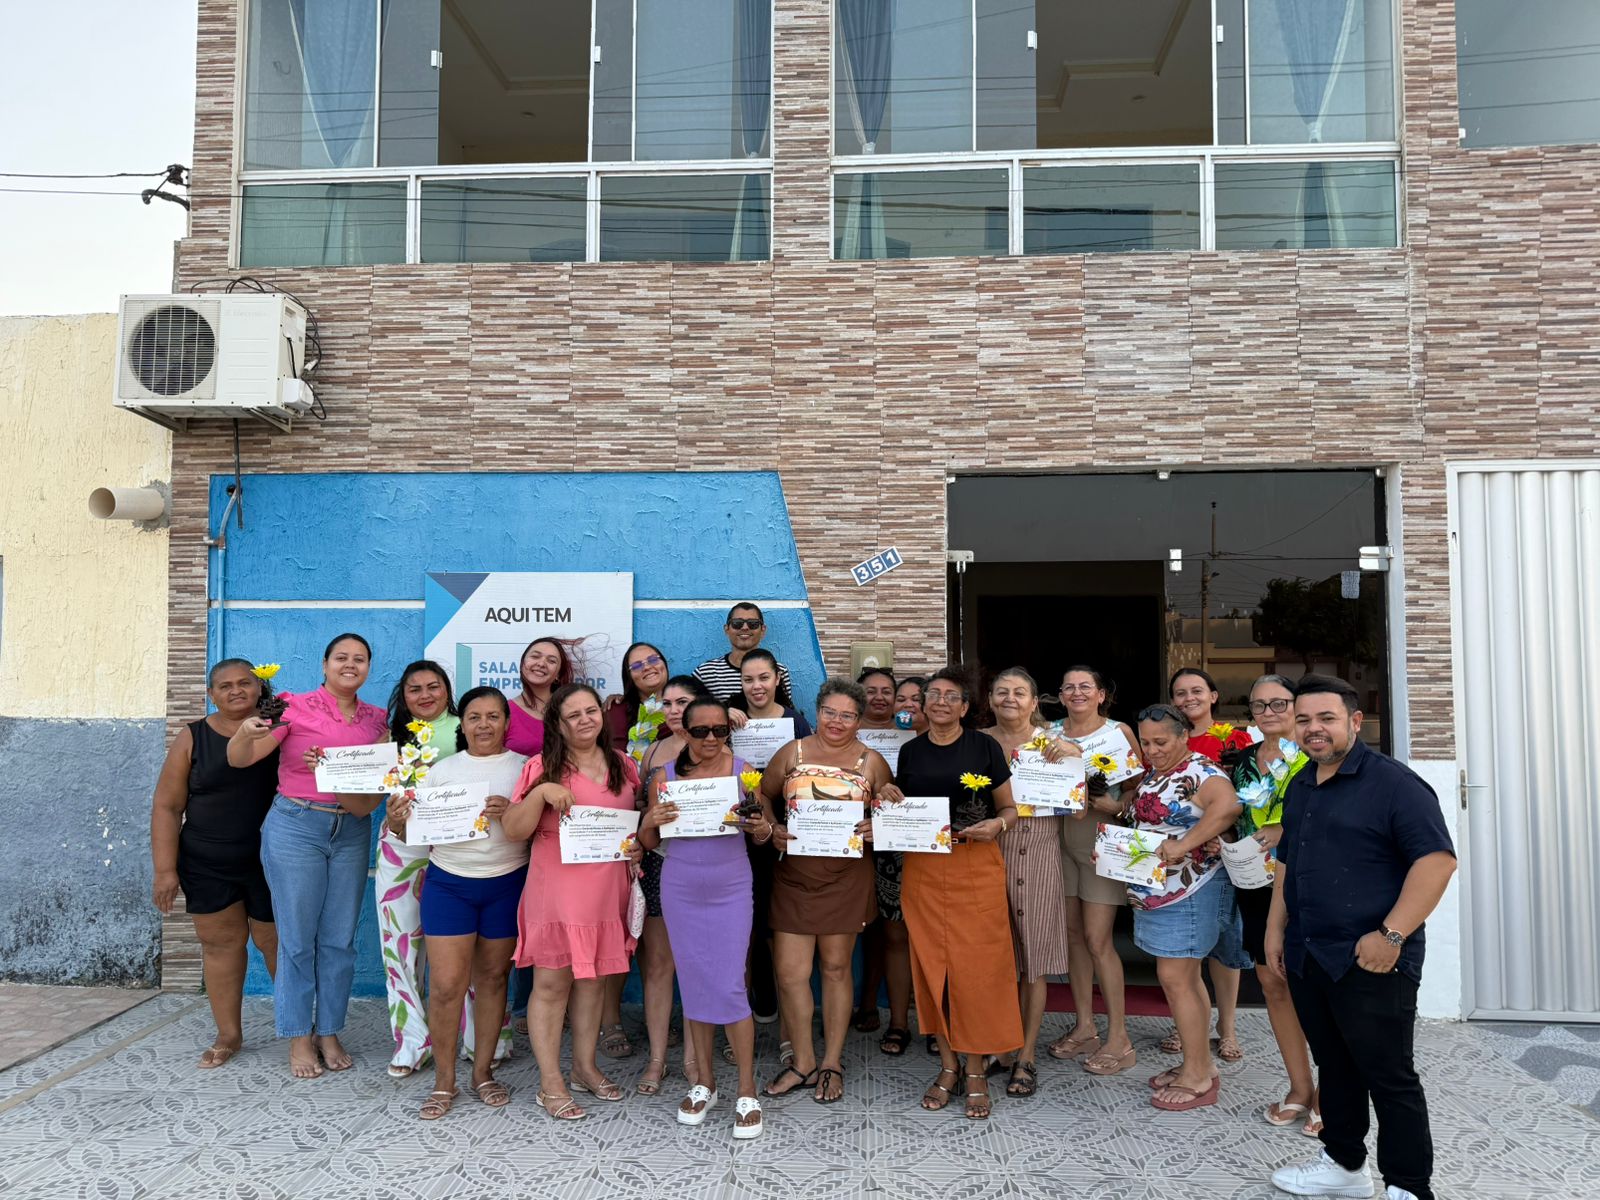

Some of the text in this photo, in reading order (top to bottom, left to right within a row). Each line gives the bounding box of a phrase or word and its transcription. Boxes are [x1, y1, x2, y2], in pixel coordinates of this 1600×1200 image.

[856, 551, 897, 580] 351
[484, 607, 572, 625] AQUI TEM
[479, 661, 519, 674] SALA
